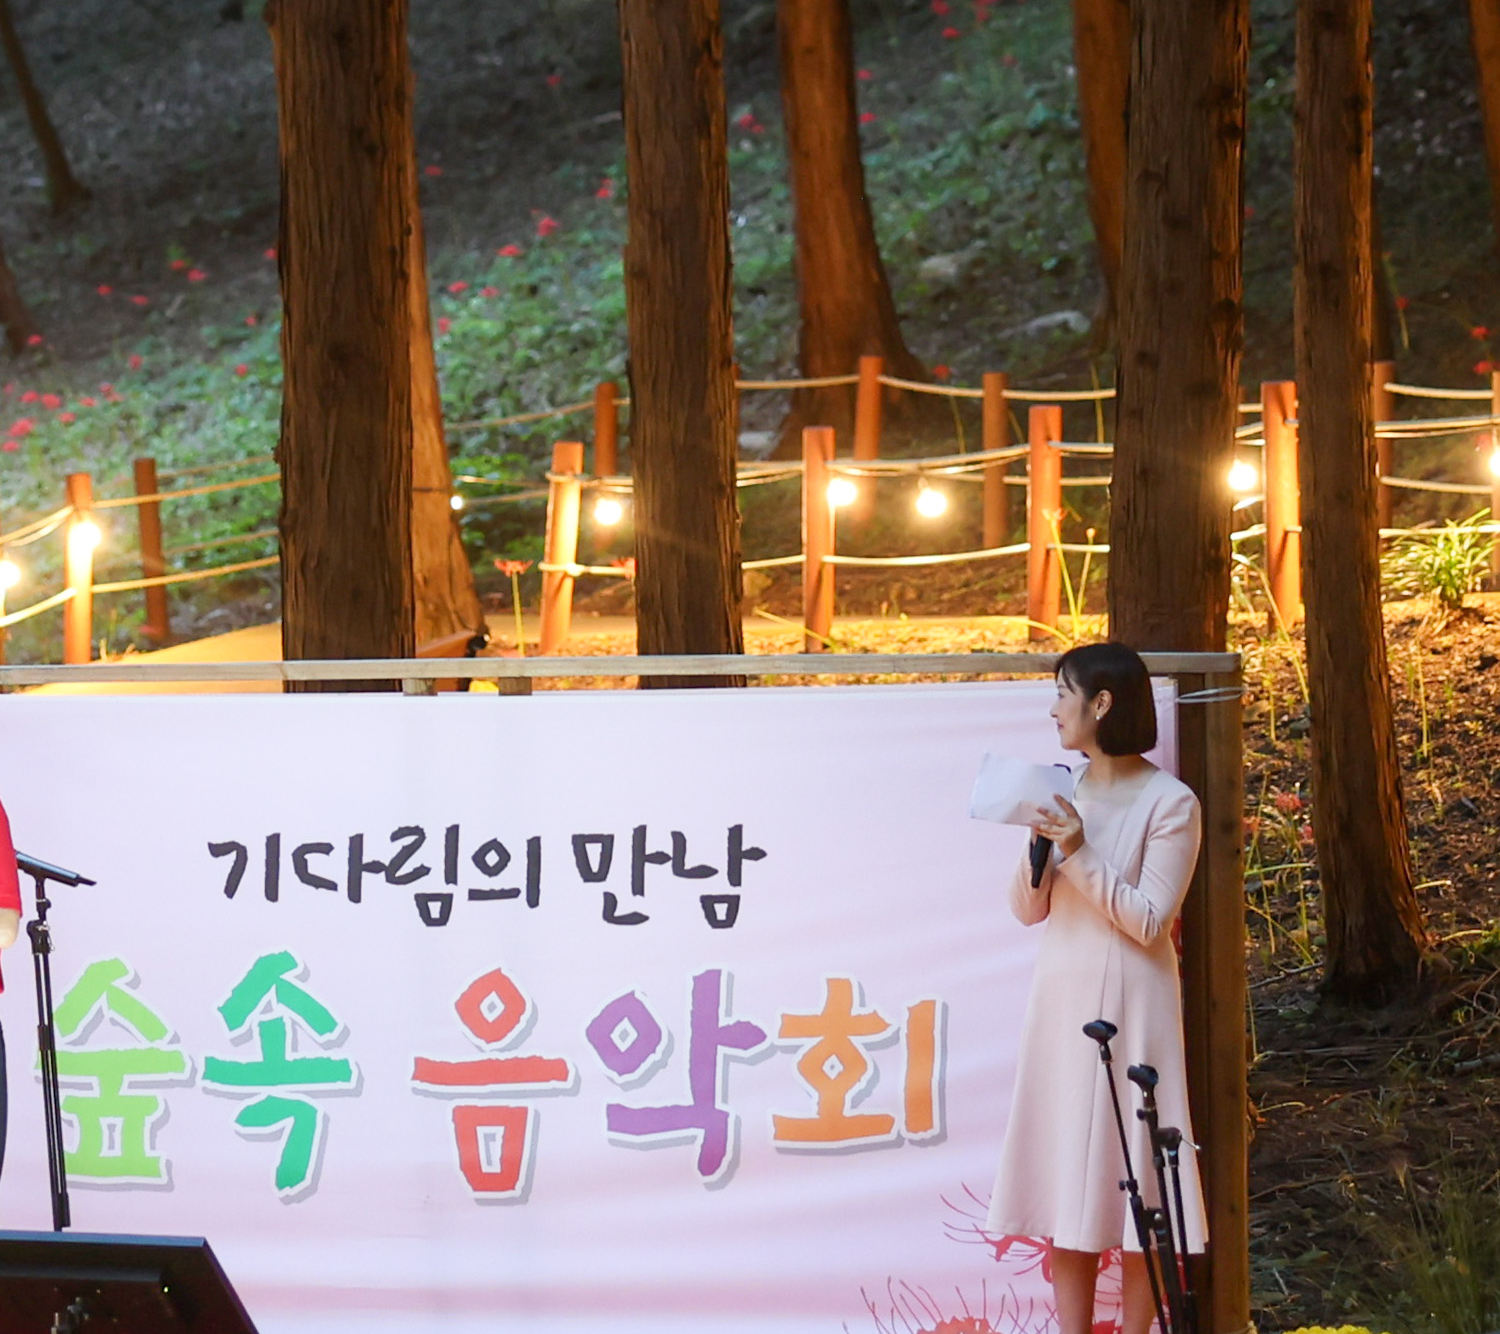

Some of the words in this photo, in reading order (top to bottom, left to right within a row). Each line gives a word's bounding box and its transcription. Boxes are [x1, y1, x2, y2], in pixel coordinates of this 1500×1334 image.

[207, 823, 541, 927] 기다림의
[571, 823, 768, 929] 만남
[410, 966, 938, 1193] 음악회
